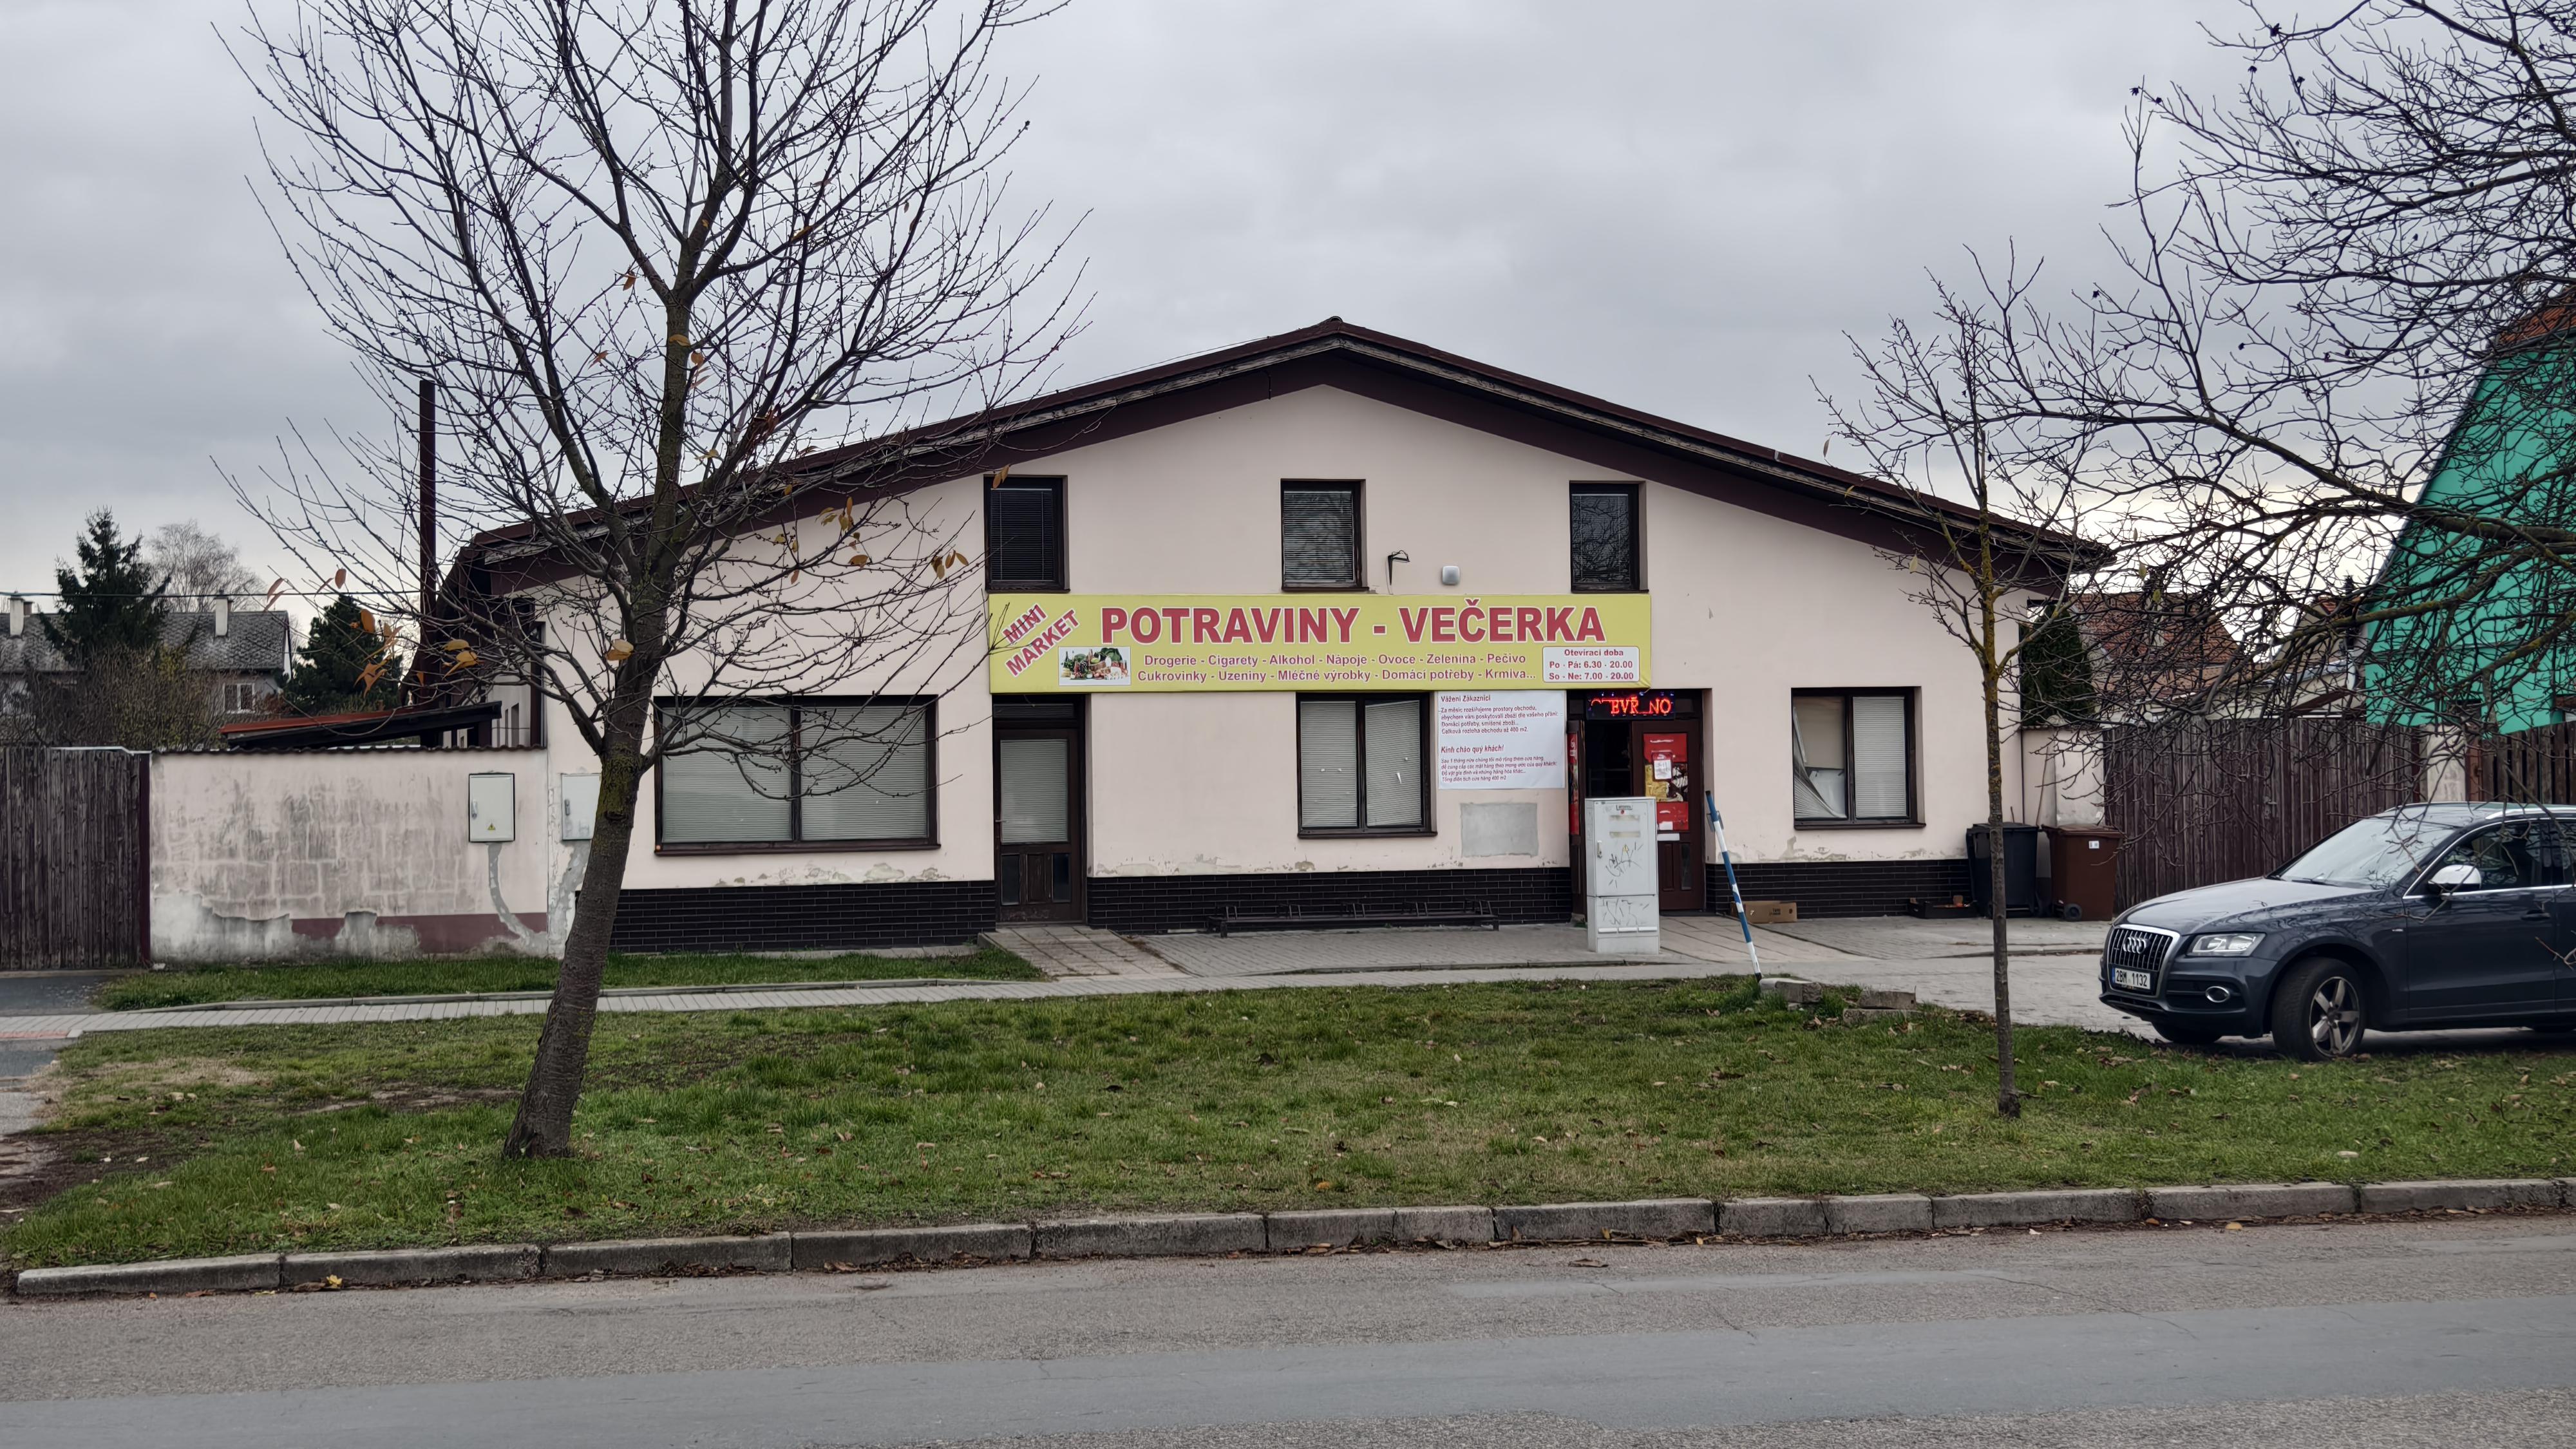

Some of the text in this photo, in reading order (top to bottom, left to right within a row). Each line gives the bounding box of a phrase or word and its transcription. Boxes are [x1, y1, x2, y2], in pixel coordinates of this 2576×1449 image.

[1002, 604, 1046, 643] MINI
[1101, 606, 1361, 645] POTRAVINY
[1398, 598, 1605, 643] VEČERKA
[1005, 609, 1079, 677] MARKET
[1144, 655, 1197, 668] Drogerie
[1208, 655, 1258, 667] Cigarety
[1269, 654, 1315, 665] Alkohol
[1326, 654, 1367, 667] Nápoje
[1379, 654, 1416, 664] Ovoce
[1426, 654, 1476, 664] Zelenina
[1487, 653, 1526, 663] Pečivo
[1138, 670, 1206, 683] Cukrovinky
[1218, 670, 1266, 683] Uzeniny
[1278, 670, 1320, 681] Mléčné
[1323, 670, 1370, 682] výrobky
[1382, 669, 1426, 679] Domácí
[1430, 669, 1474, 681] potřeby
[1486, 669, 1536, 679] Krmiva...
[2116, 970, 2147, 987] 2BM 1132
